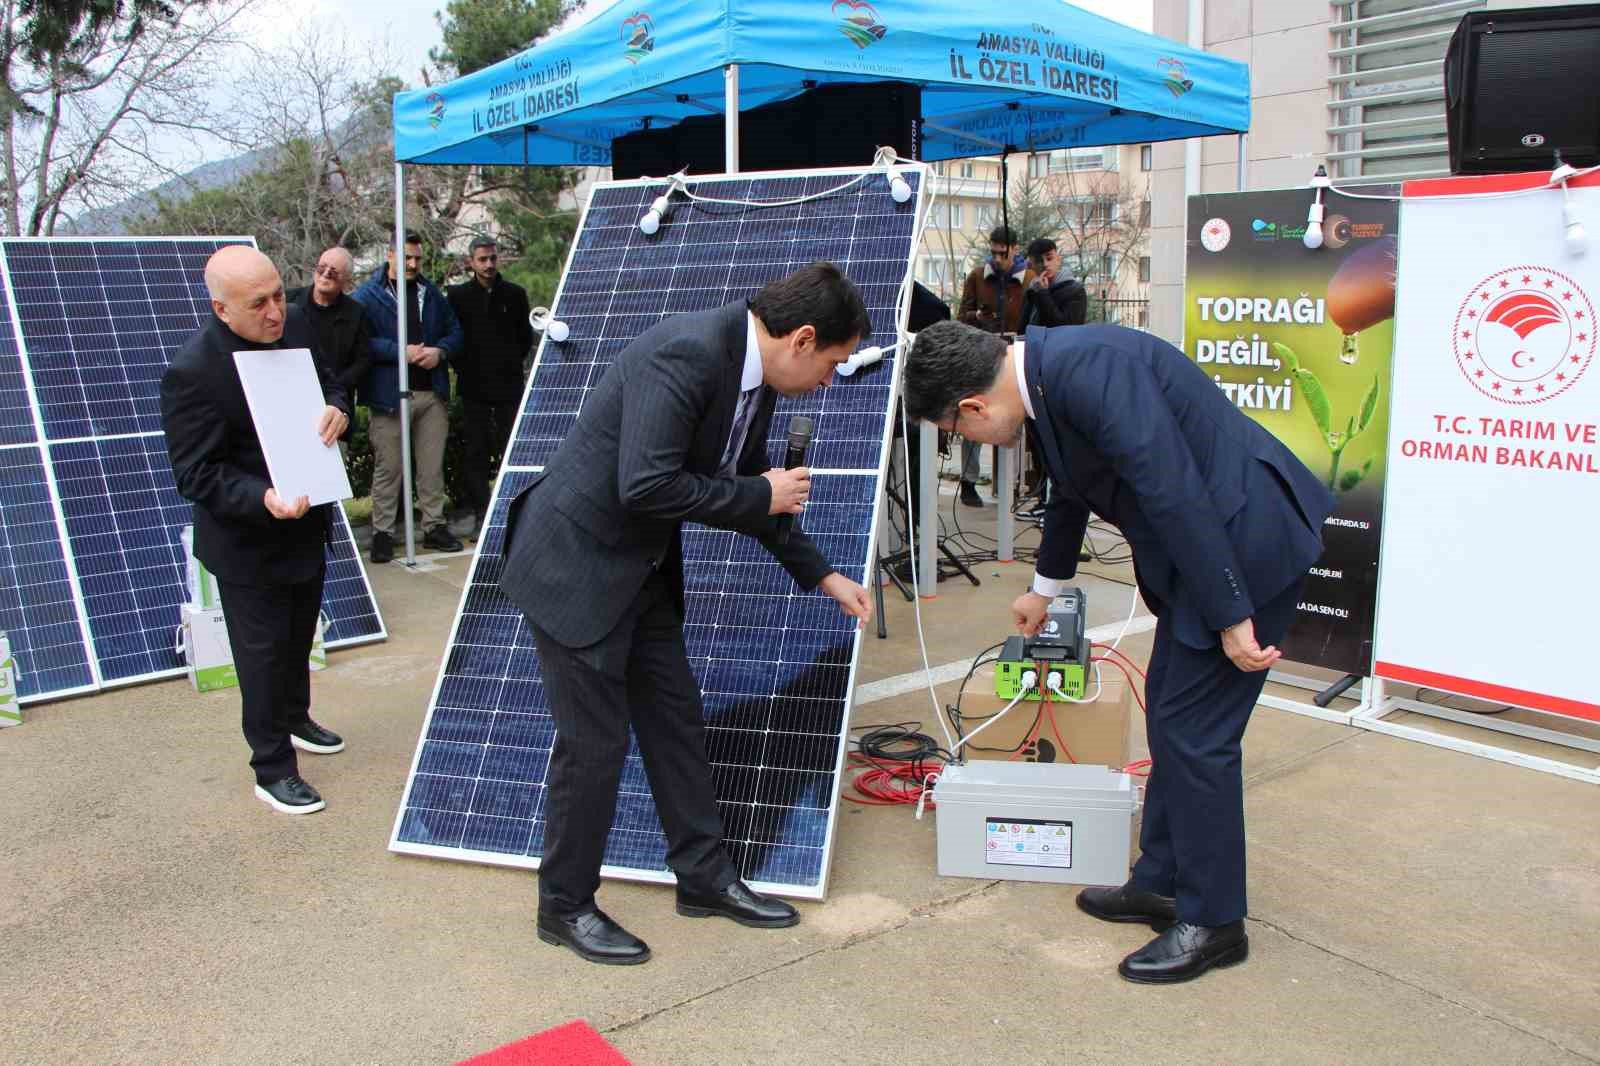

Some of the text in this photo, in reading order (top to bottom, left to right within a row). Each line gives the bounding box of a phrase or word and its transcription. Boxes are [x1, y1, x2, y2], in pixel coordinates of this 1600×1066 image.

[976, 32, 1105, 71] AMASYA VALİLİĞİ
[950, 48, 1119, 101] İL ÖZEL İDARESİ
[472, 106, 484, 133] İL
[486, 96, 520, 128] ÖZEL
[523, 76, 580, 119] İDARESİ
[1197, 291, 1326, 324] TOPRAĞI
[1196, 333, 1281, 372] DEĞİL,
[1434, 414, 1597, 444] T.C. TARIM VE
[1401, 439, 1600, 474] ORMAN BAKANL
[1358, 520, 1370, 530] SU
[1319, 604, 1335, 616] SEN
